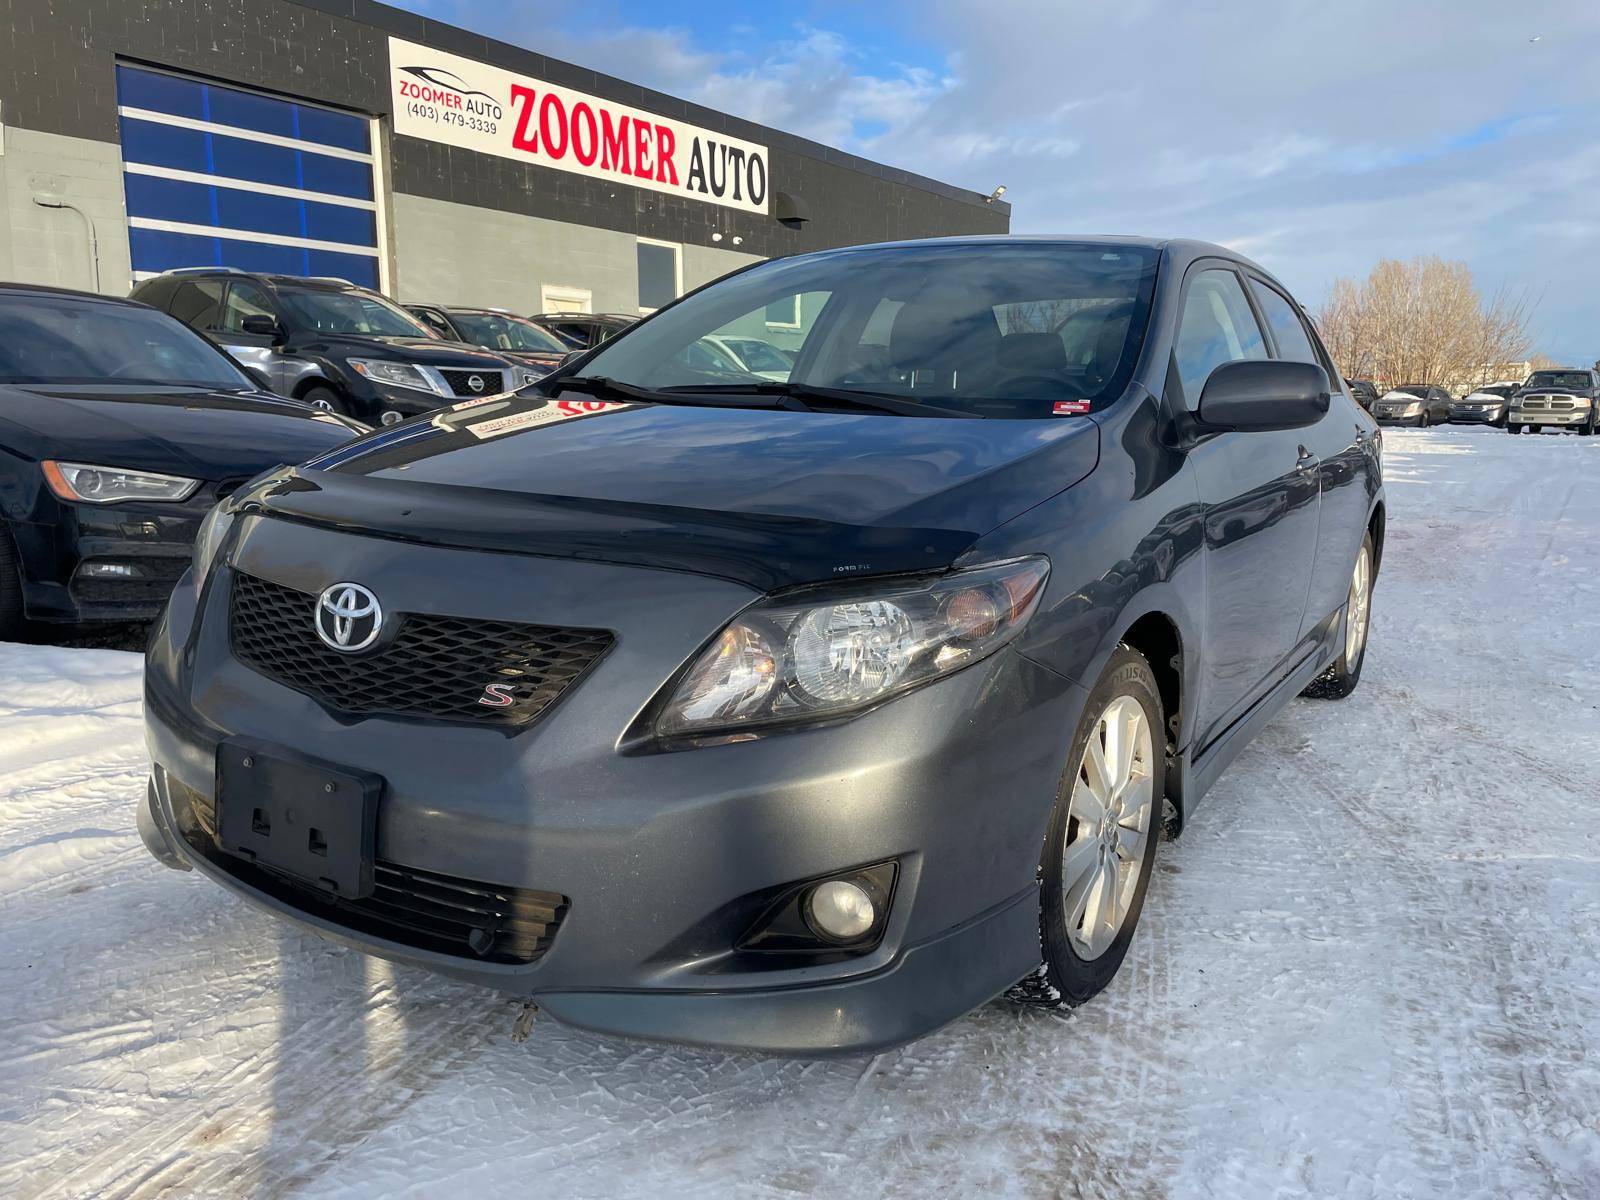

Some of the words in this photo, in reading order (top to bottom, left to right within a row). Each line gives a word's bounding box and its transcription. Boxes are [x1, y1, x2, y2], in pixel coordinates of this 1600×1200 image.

[400, 80, 462, 110] ZOOMER
[466, 98, 502, 120] AUTO
[407, 101, 439, 124] (403)
[443, 111, 497, 135] 479-3339
[511, 83, 679, 186] ZOOMER
[686, 136, 765, 206] AUTO
[479, 683, 516, 707] S
